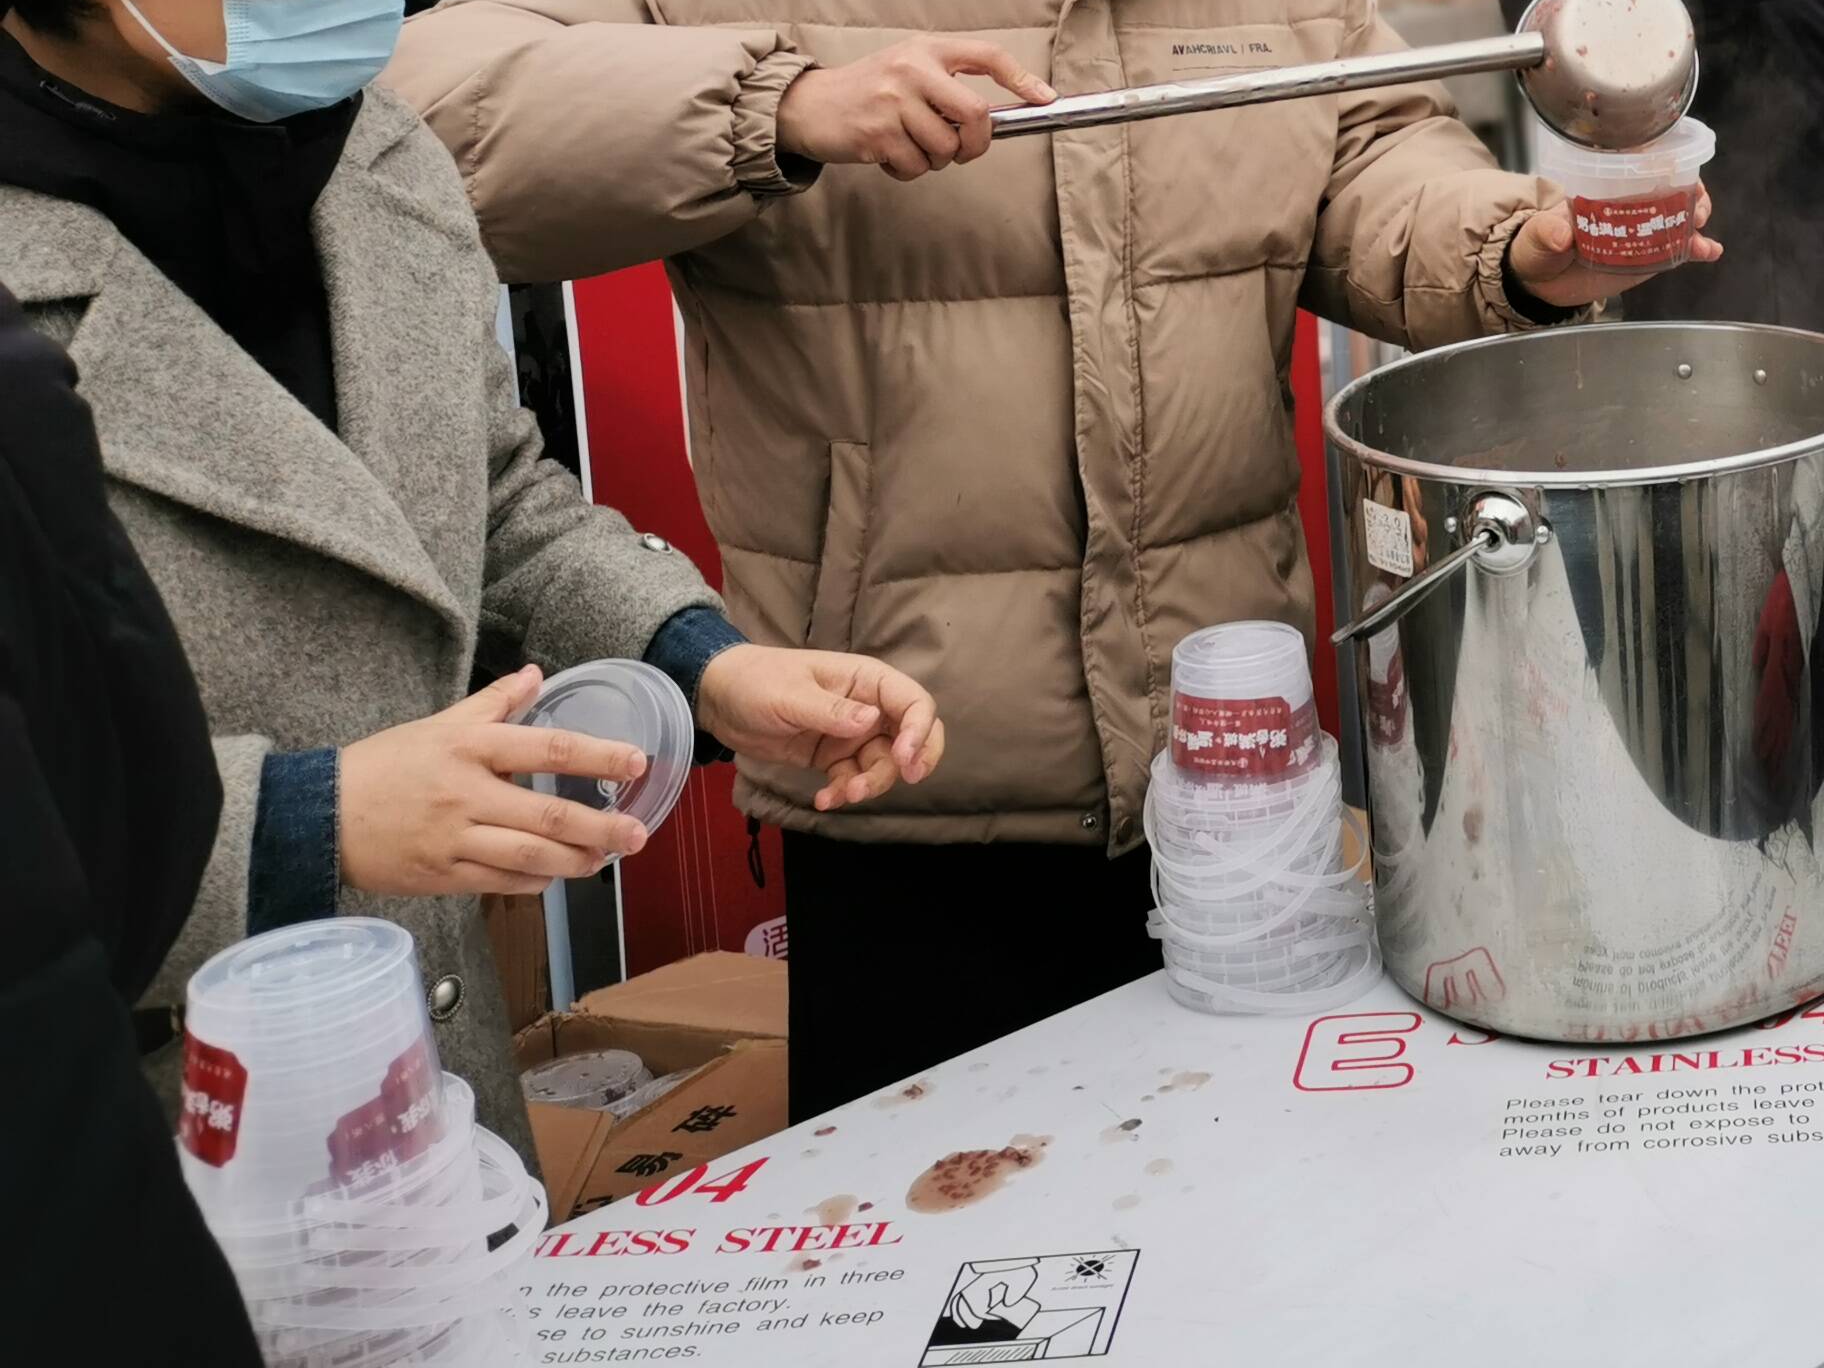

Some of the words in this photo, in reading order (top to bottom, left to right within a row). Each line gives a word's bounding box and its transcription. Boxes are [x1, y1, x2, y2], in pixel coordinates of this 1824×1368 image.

[1506, 1097, 1585, 1109] Please
[1599, 1091, 1644, 1103] tear
[1656, 1085, 1719, 1099] down
[1731, 1084, 1767, 1096] the
[1503, 1109, 1590, 1125] months
[1603, 1107, 1626, 1118] of
[1637, 1100, 1740, 1120] products
[1753, 1099, 1816, 1111] leave
[1502, 1127, 1583, 1140] Please
[1596, 1123, 1627, 1134] do
[1640, 1119, 1676, 1132] not
[1689, 1116, 1776, 1131] expose
[1788, 1113, 1811, 1125] to
[1498, 1143, 1563, 1158] away
[1576, 1139, 1631, 1153] from
[1642, 1134, 1753, 1151] corrosive
[714, 1220, 904, 1255] STEEL
[546, 1282, 588, 1298] the
[598, 1280, 730, 1301] protective
[743, 1276, 788, 1292] film
[803, 1272, 826, 1288] in
[839, 1268, 905, 1284] three
[555, 1303, 629, 1320] leave
[643, 1302, 684, 1317] the
[697, 1295, 791, 1315] factory.
[582, 1325, 607, 1341] to
[620, 1318, 741, 1340] sunshine
[756, 1313, 807, 1333] and
[819, 1309, 885, 1328] keep
[540, 1343, 702, 1365] substances.
